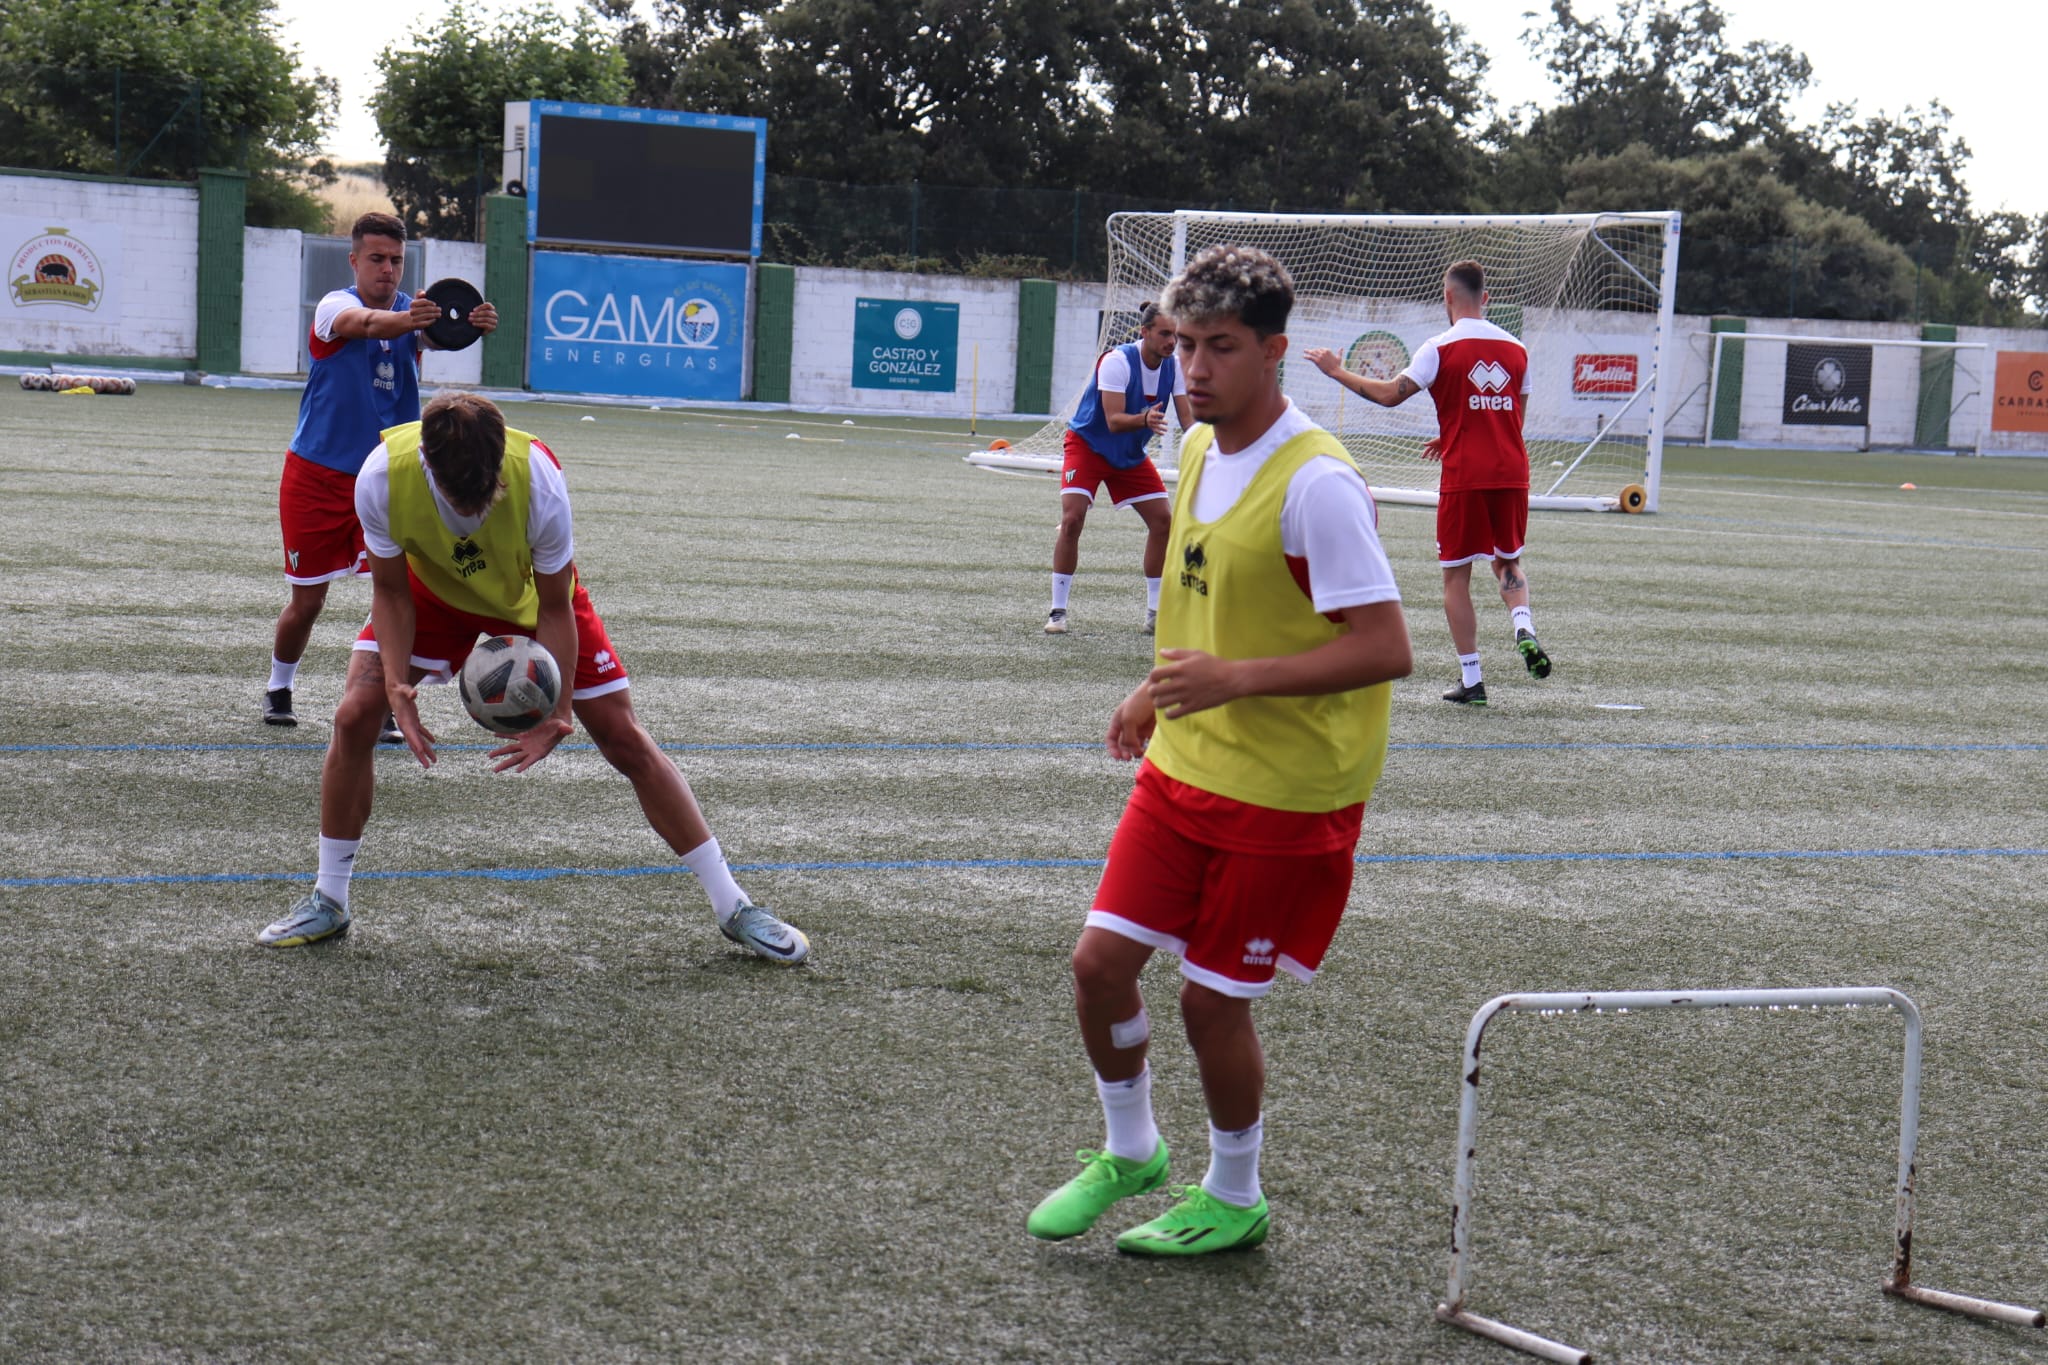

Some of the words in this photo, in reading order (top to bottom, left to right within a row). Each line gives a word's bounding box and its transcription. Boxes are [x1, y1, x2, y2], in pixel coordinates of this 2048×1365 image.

[17, 238, 62, 269] PRODUCTOS
[544, 289, 720, 347] GAMO
[544, 347, 717, 371] ENERGÍAS
[872, 346, 926, 361] CASTRO
[929, 349, 939, 361] Y
[869, 360, 941, 376] GONZÁLEZ
[1468, 394, 1513, 411] errea
[455, 560, 486, 578] rrea
[1242, 954, 1273, 966] errea
